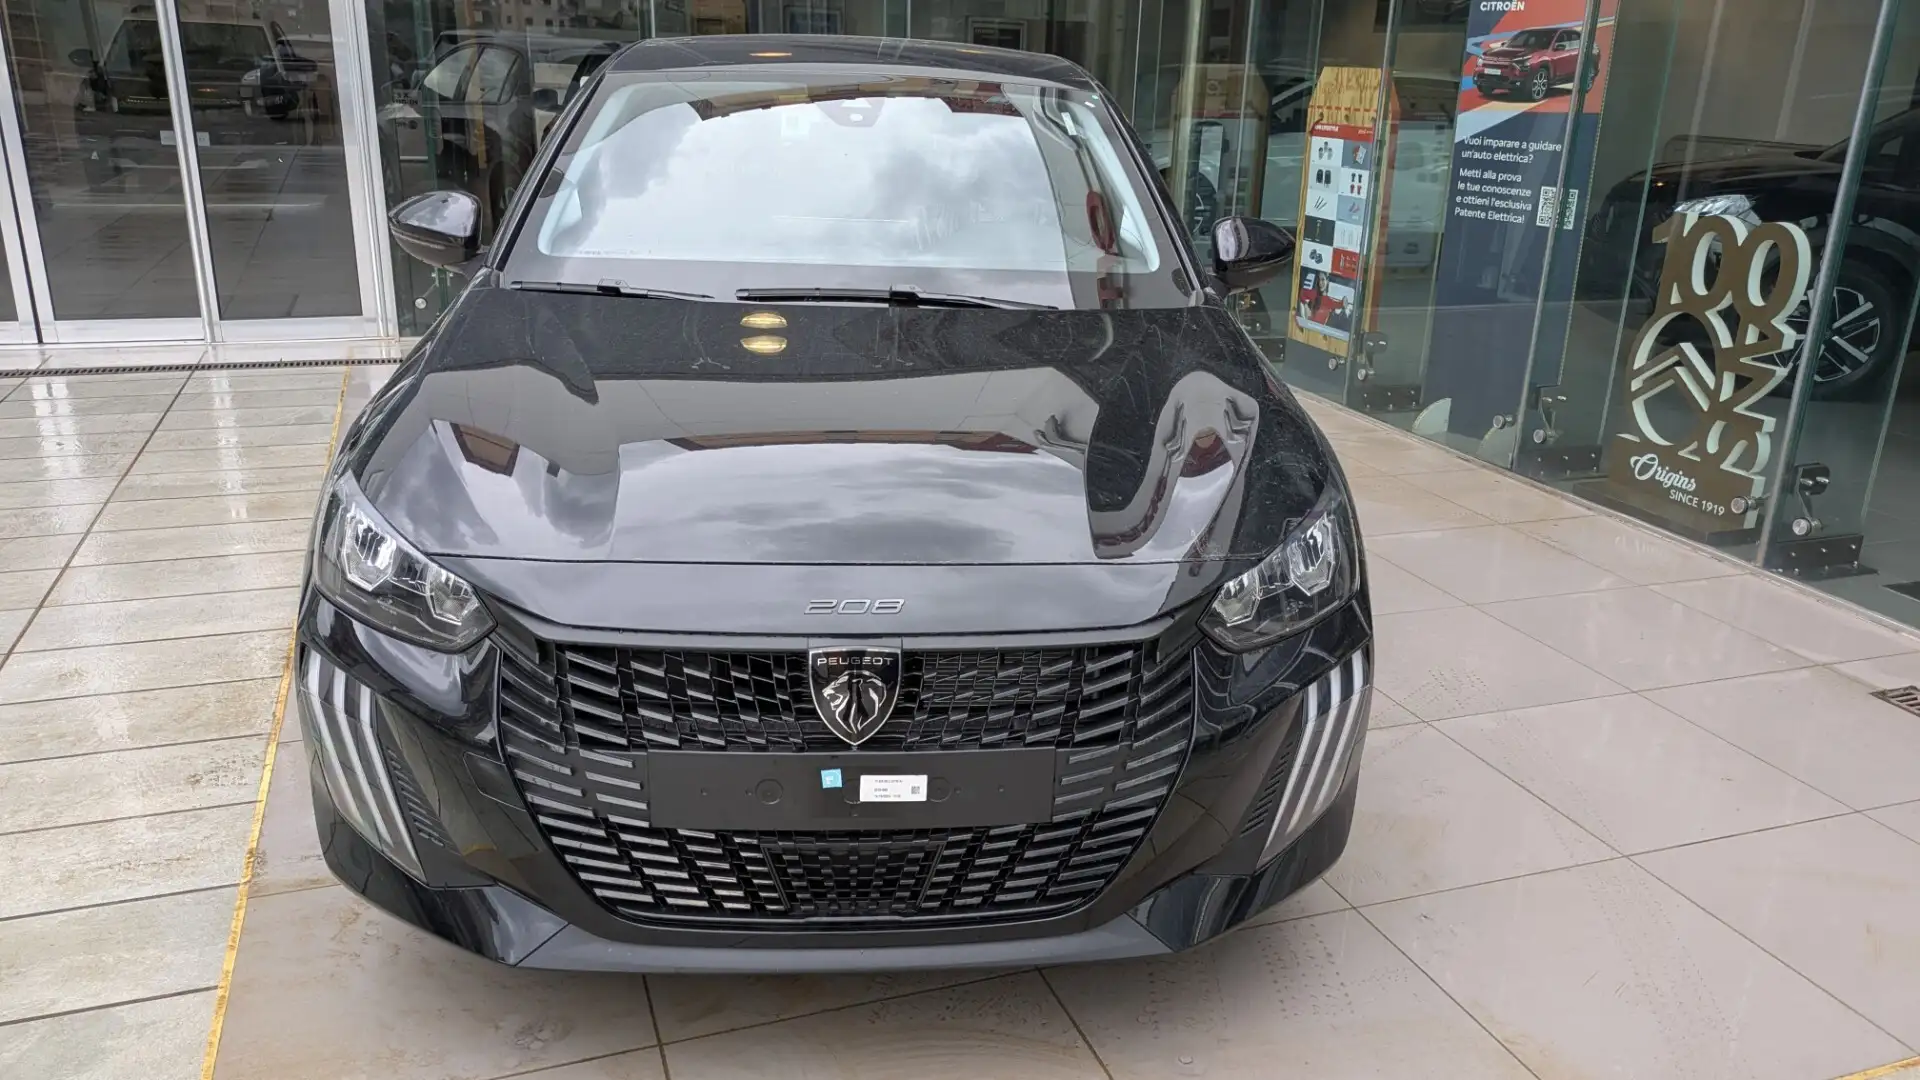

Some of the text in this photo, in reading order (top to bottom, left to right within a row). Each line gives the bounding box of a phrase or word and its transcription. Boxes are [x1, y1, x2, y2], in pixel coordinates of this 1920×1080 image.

[1480, 0, 1525, 11] CITROËN
[1463, 136, 1482, 146] Vuoi
[1483, 137, 1520, 149] imparare
[1528, 141, 1562, 152] guidare
[1461, 150, 1534, 163] un'auto elettrica?
[1459, 168, 1522, 182] Metti alla prova
[1457, 180, 1532, 197] le tue conoscenze
[1455, 195, 1532, 211] e ottieni l'esclusiva
[1454, 206, 1525, 224] Patente Elettrica!
[1652, 212, 1812, 308] 100
[1630, 453, 1697, 491] Origins
[1669, 489, 1725, 516] SINCE 1919
[804, 598, 905, 615] 208
[817, 656, 894, 666] PEUGEOT
